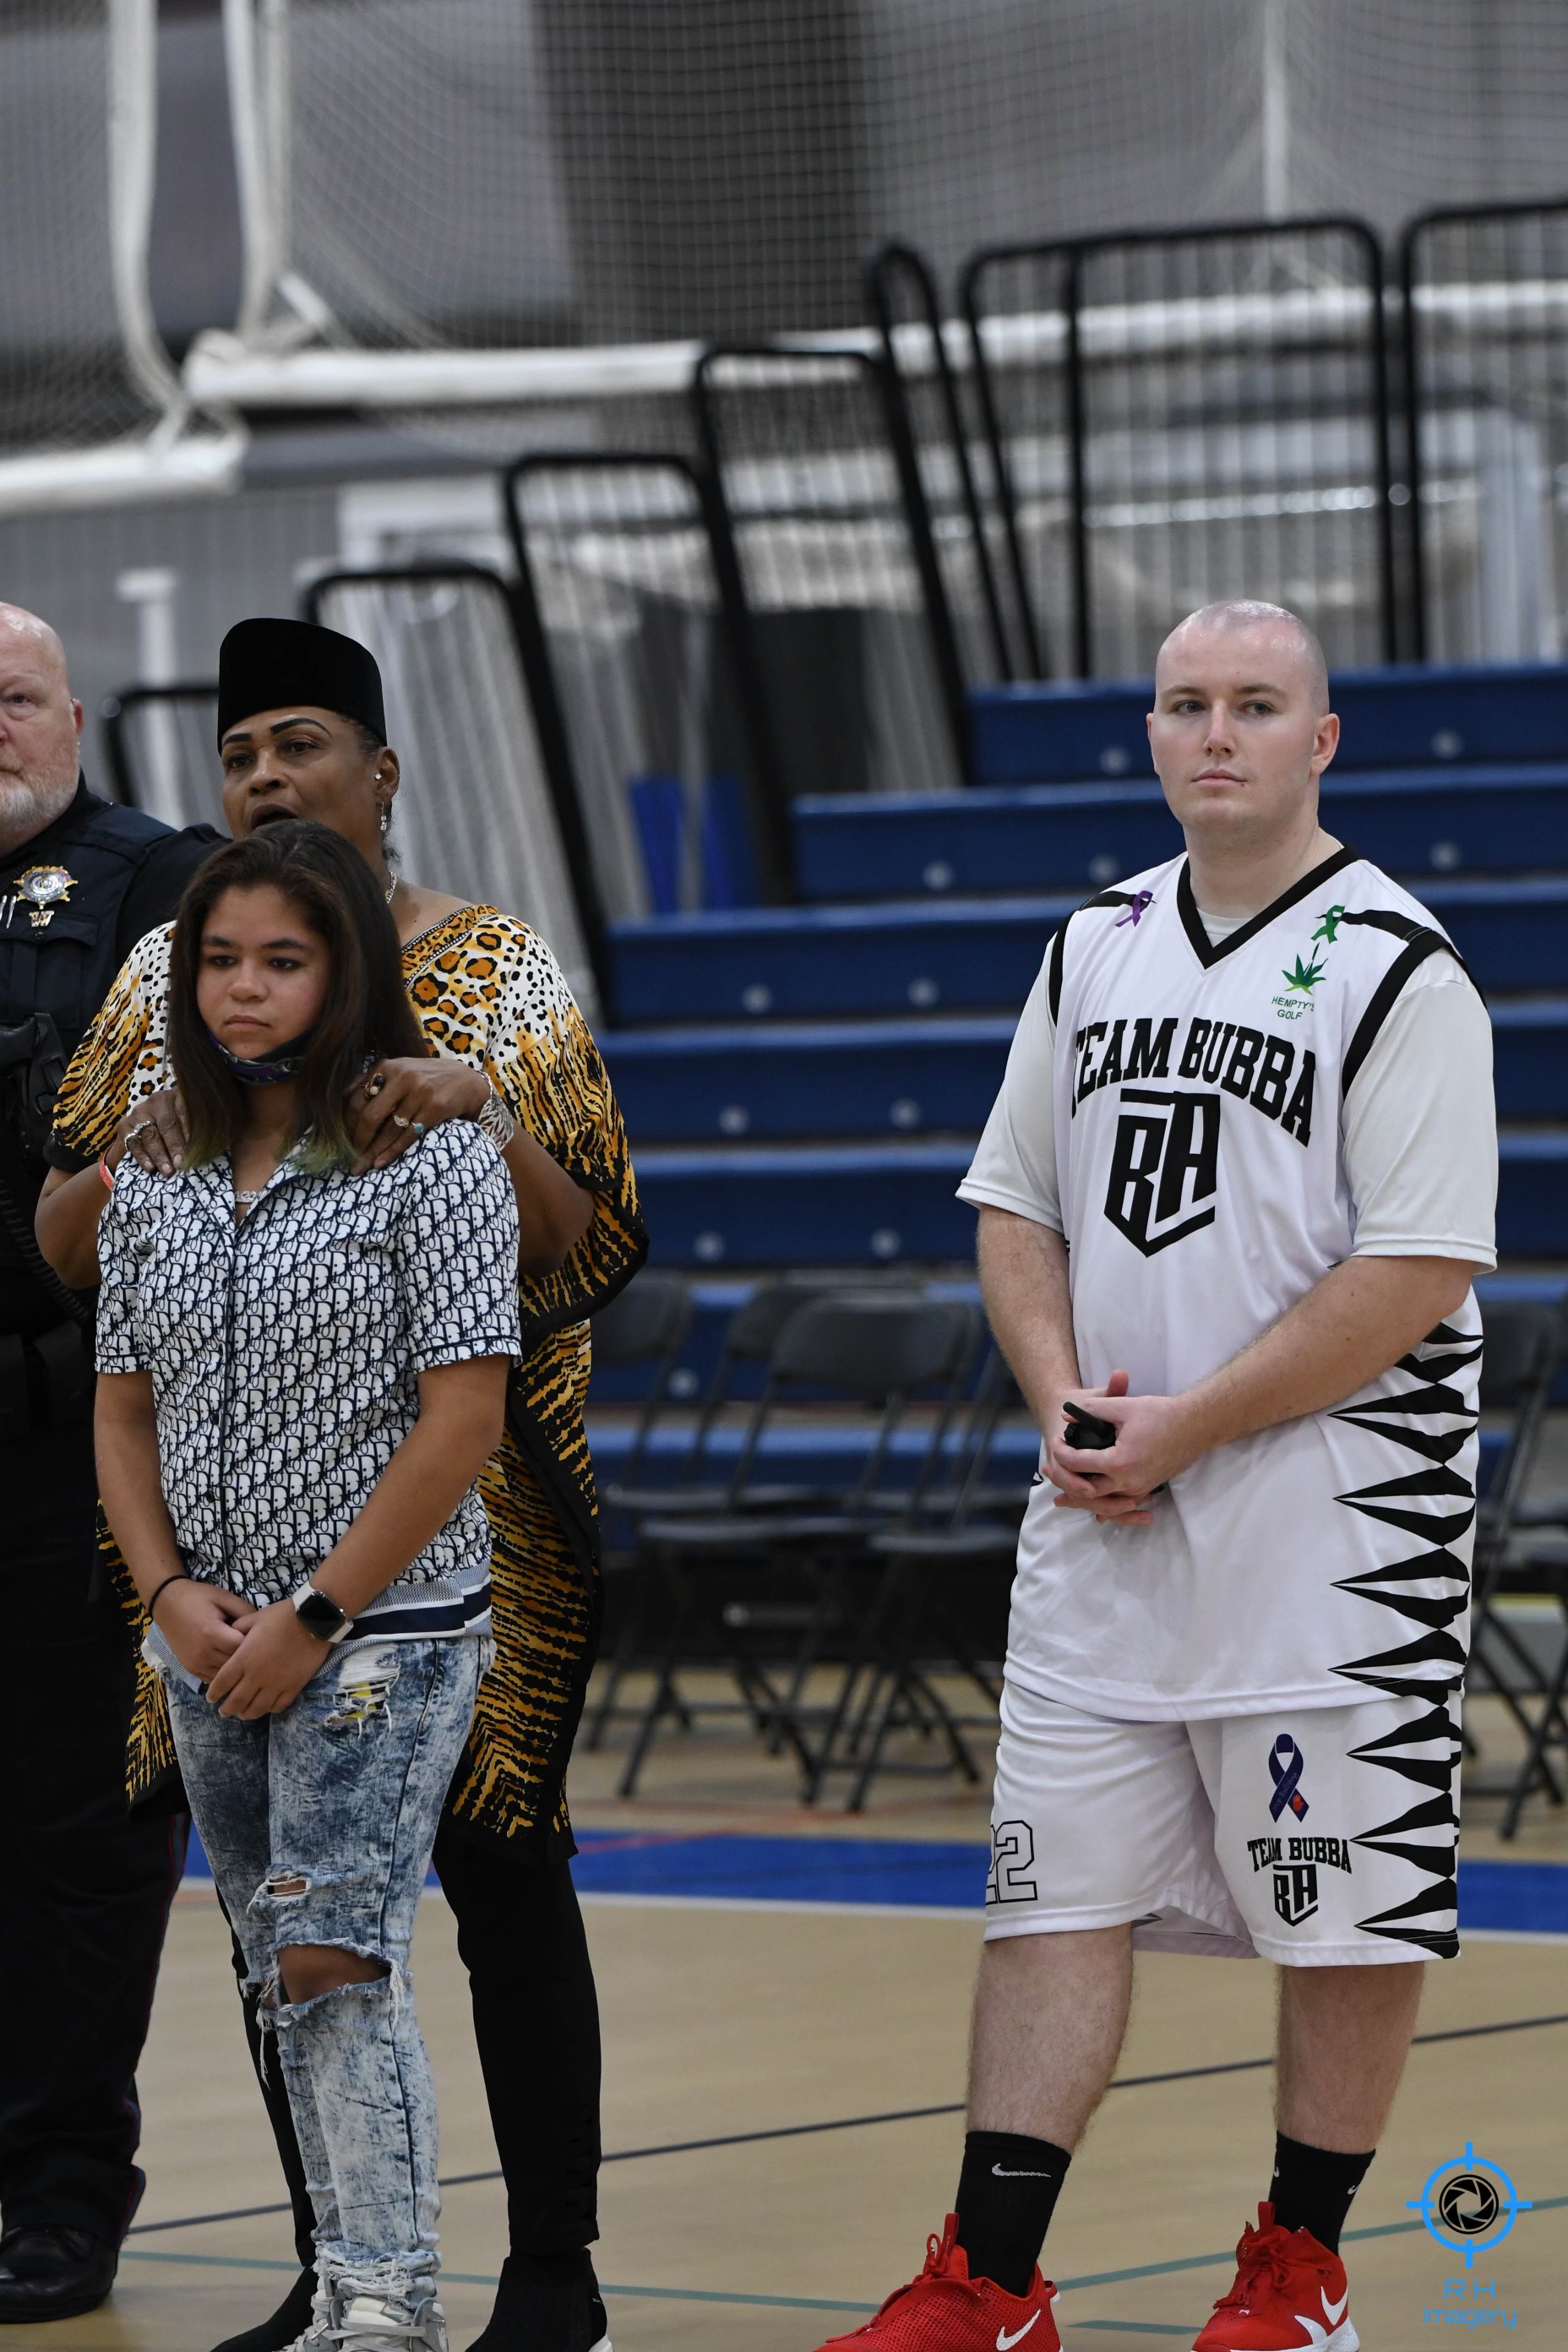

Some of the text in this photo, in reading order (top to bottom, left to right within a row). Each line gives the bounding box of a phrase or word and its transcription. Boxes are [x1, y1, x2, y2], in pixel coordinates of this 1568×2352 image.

[1277, 1009, 1303, 1020] GOLF
[1071, 1016, 1316, 1148] TEAM BUBBA
[1247, 1837, 1353, 1875] TEAM BUBBA
